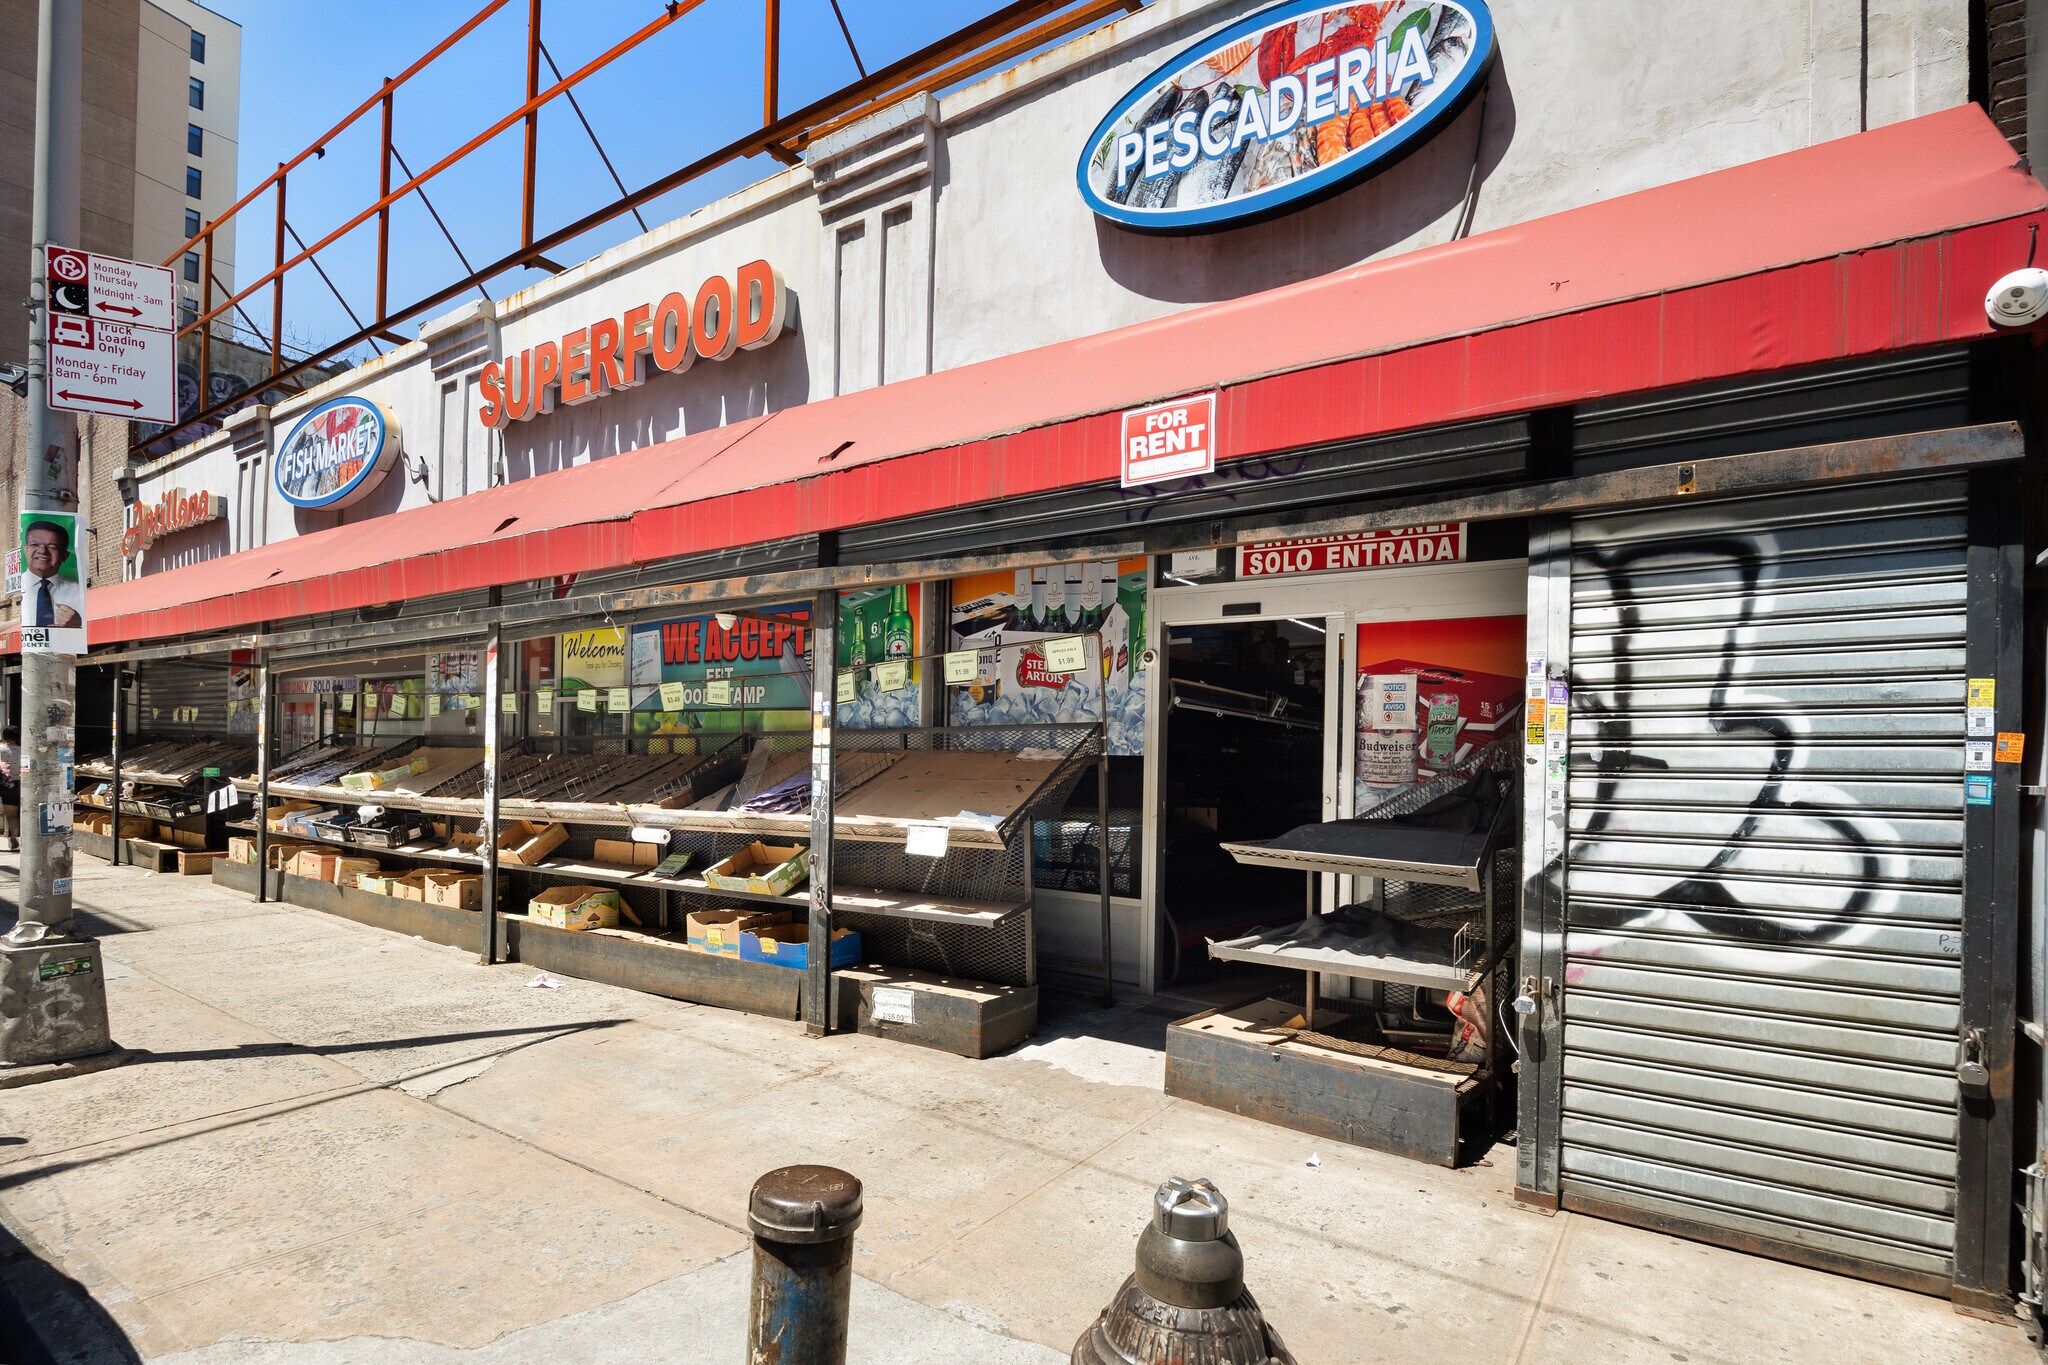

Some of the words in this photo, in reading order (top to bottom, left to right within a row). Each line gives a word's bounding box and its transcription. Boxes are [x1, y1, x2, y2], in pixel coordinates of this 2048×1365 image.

[1115, 26, 1435, 191] PESCADERIA
[93, 262, 131, 278] Monday
[93, 272, 138, 289] Thursday
[93, 286, 134, 301] Midnight
[143, 295, 163, 306] 3am
[99, 321, 132, 335] Truck
[98, 332, 145, 350] Loading
[98, 342, 125, 357] Only
[479, 258, 778, 429] SUPERFOOD
[55, 355, 100, 373] Monday
[112, 364, 146, 379] Friday
[55, 368, 81, 380] 8am
[93, 373, 117, 385] 6pm
[1146, 409, 1188, 432] FOR
[1129, 423, 1206, 460] RENT
[284, 450, 313, 483] FISH
[315, 419, 375, 472] MARKET
[121, 487, 209, 556] Antillana
[1250, 551, 1313, 575] SOLO
[1326, 536, 1454, 569] ENTRADA
[871, 622, 878, 634] 6
[662, 619, 700, 664] WE
[703, 610, 810, 662] ACCEPT
[564, 633, 625, 659] Welcome
[1058, 657, 1075, 665] $1.99
[1026, 670, 1064, 684] ARTOIS
[313, 679, 331, 693] SOLO
[1384, 683, 1406, 691] NOTICE
[1480, 701, 1490, 709] 15
[1431, 726, 1454, 735] HARD
[1359, 738, 1417, 751] Budweiser
[1134, 1295, 1180, 1329] OPEN
